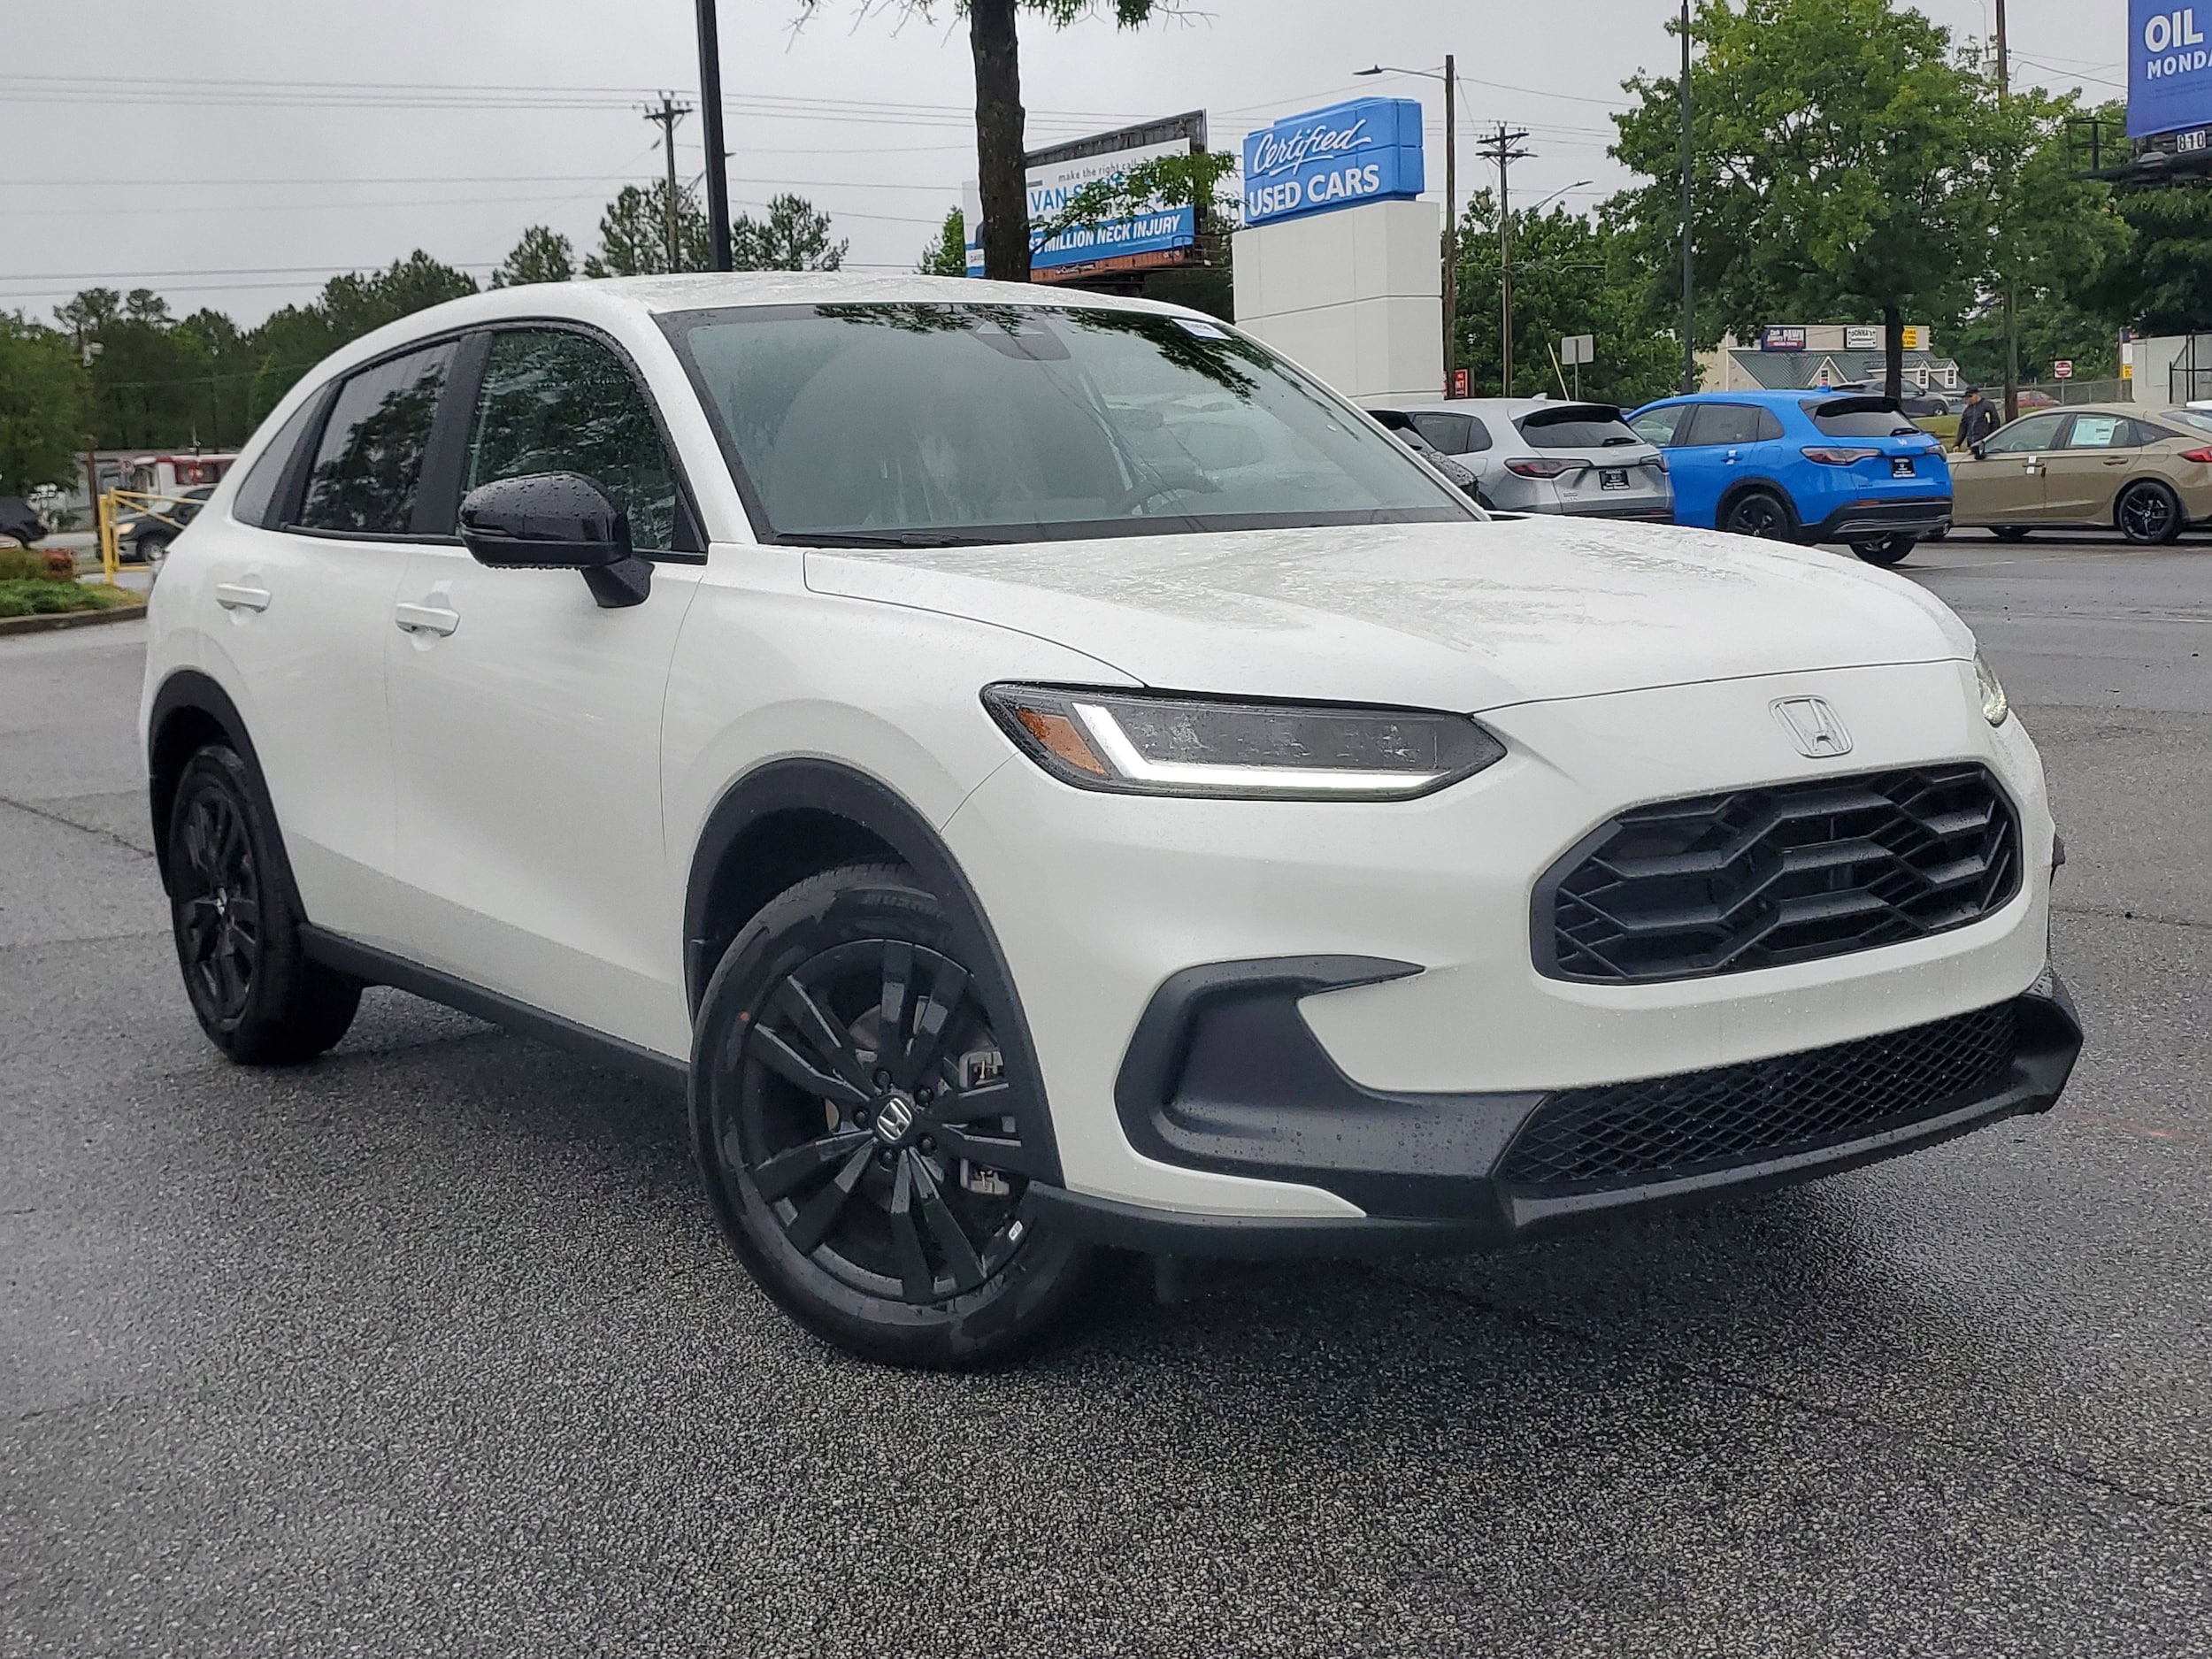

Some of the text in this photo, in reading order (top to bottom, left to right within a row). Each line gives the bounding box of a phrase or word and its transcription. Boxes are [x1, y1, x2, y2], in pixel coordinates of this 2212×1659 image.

[2145, 8, 2203, 52] OIL
[1253, 119, 1371, 176] Certified
[2177, 132, 2205, 151] 810
[1058, 169, 1080, 182] make
[1083, 166, 1096, 178] the
[1099, 162, 1119, 177] right
[1248, 164, 1380, 217] USED CARS
[1030, 185, 1068, 212] VAN
[1044, 230, 1094, 253] MILLION
[1097, 221, 1131, 245] NECK
[1133, 214, 1181, 238] INJURY
